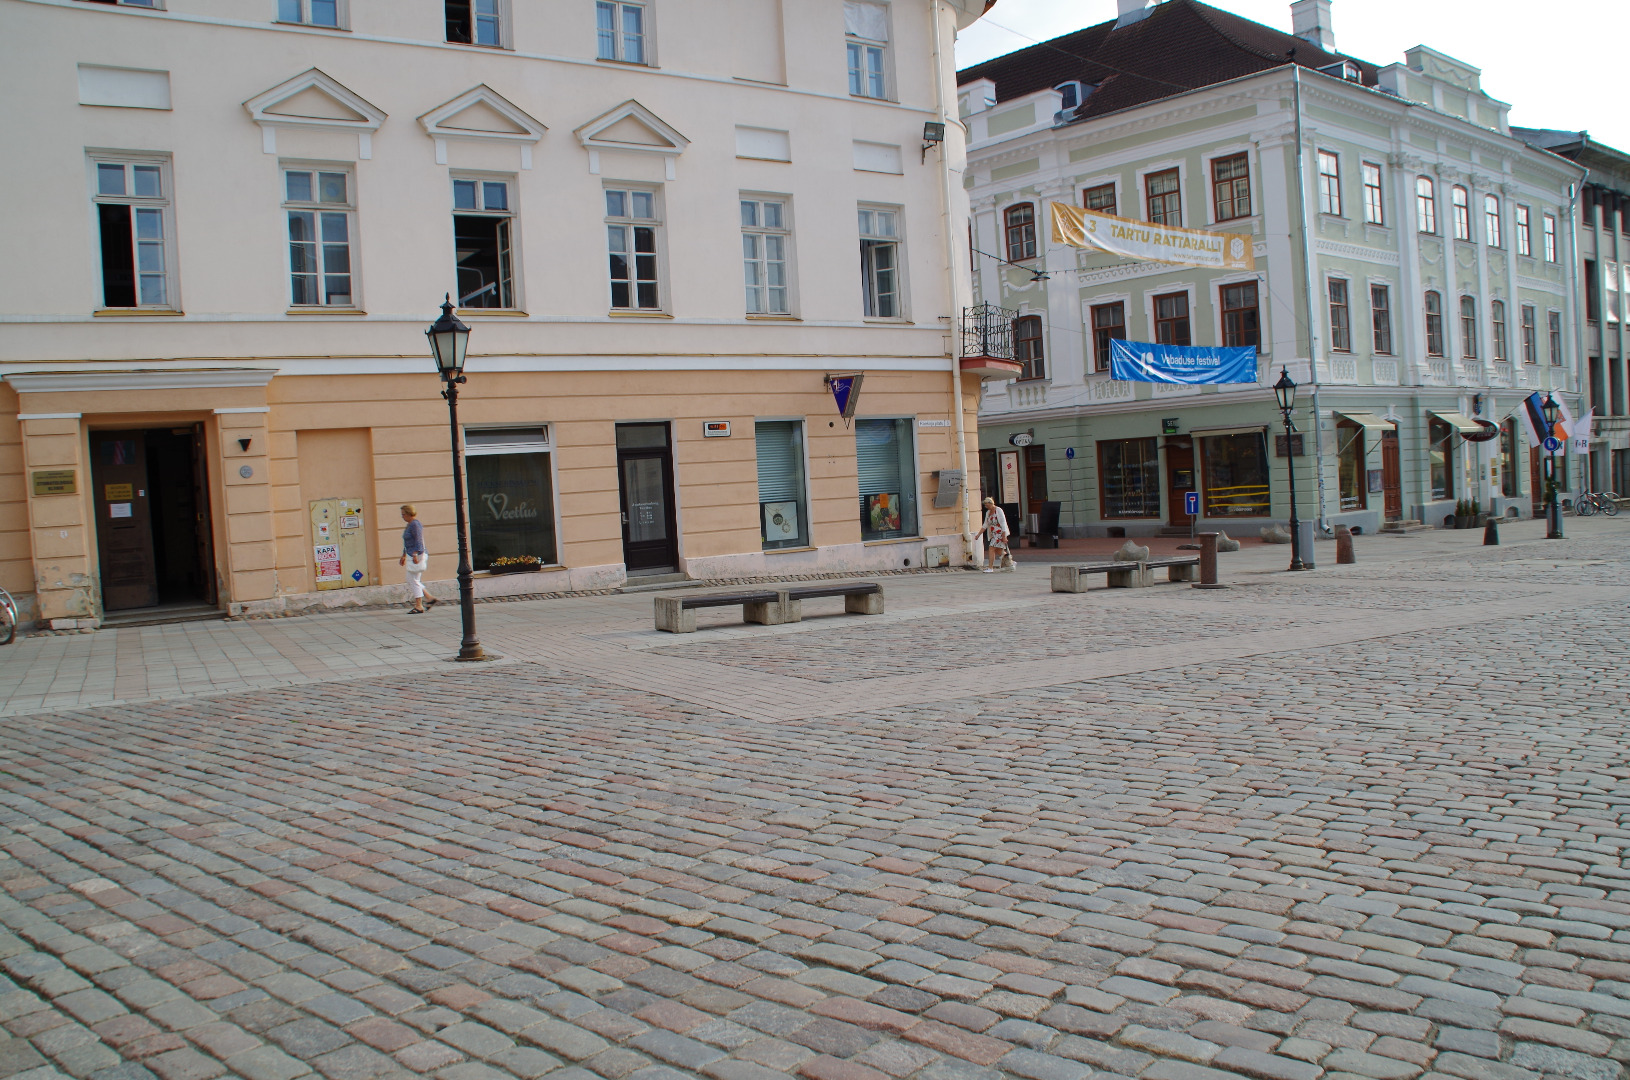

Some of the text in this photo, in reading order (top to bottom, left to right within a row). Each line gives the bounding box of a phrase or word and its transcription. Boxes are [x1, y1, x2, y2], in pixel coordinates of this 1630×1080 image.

[1110, 224, 1150, 243] TARTU
[1153, 232, 1221, 252] RATTARALLI
[1161, 353, 1221, 366] Vabaduse festival
